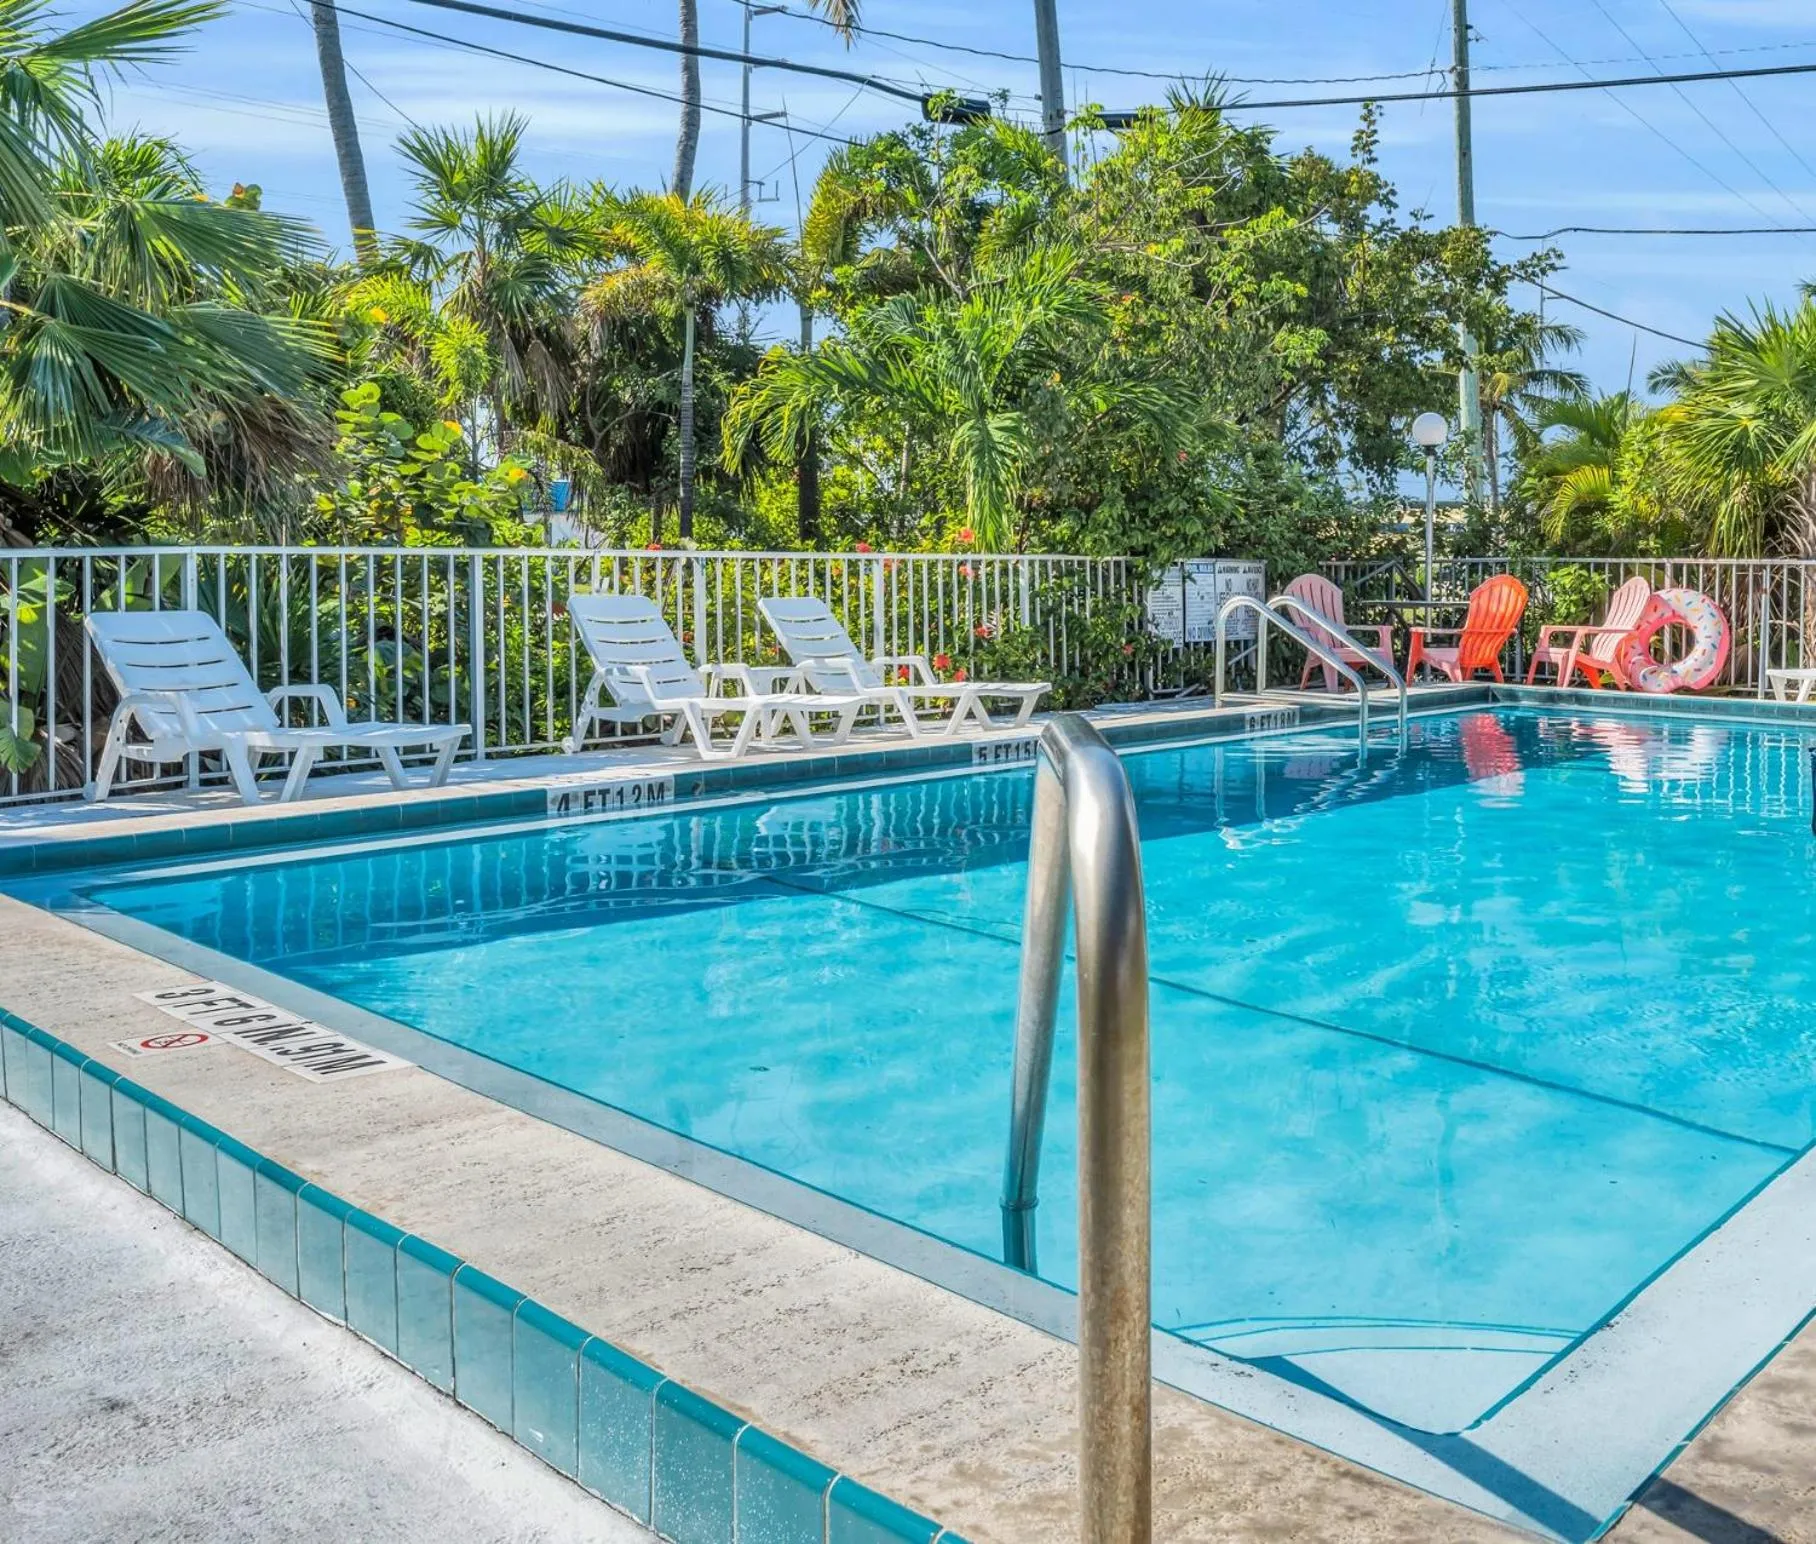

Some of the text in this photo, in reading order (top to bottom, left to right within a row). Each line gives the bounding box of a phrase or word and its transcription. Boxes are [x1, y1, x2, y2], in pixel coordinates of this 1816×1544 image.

[154, 988, 216, 1000] 3
[172, 997, 256, 1015] FT
[213, 1013, 278, 1026] 6
